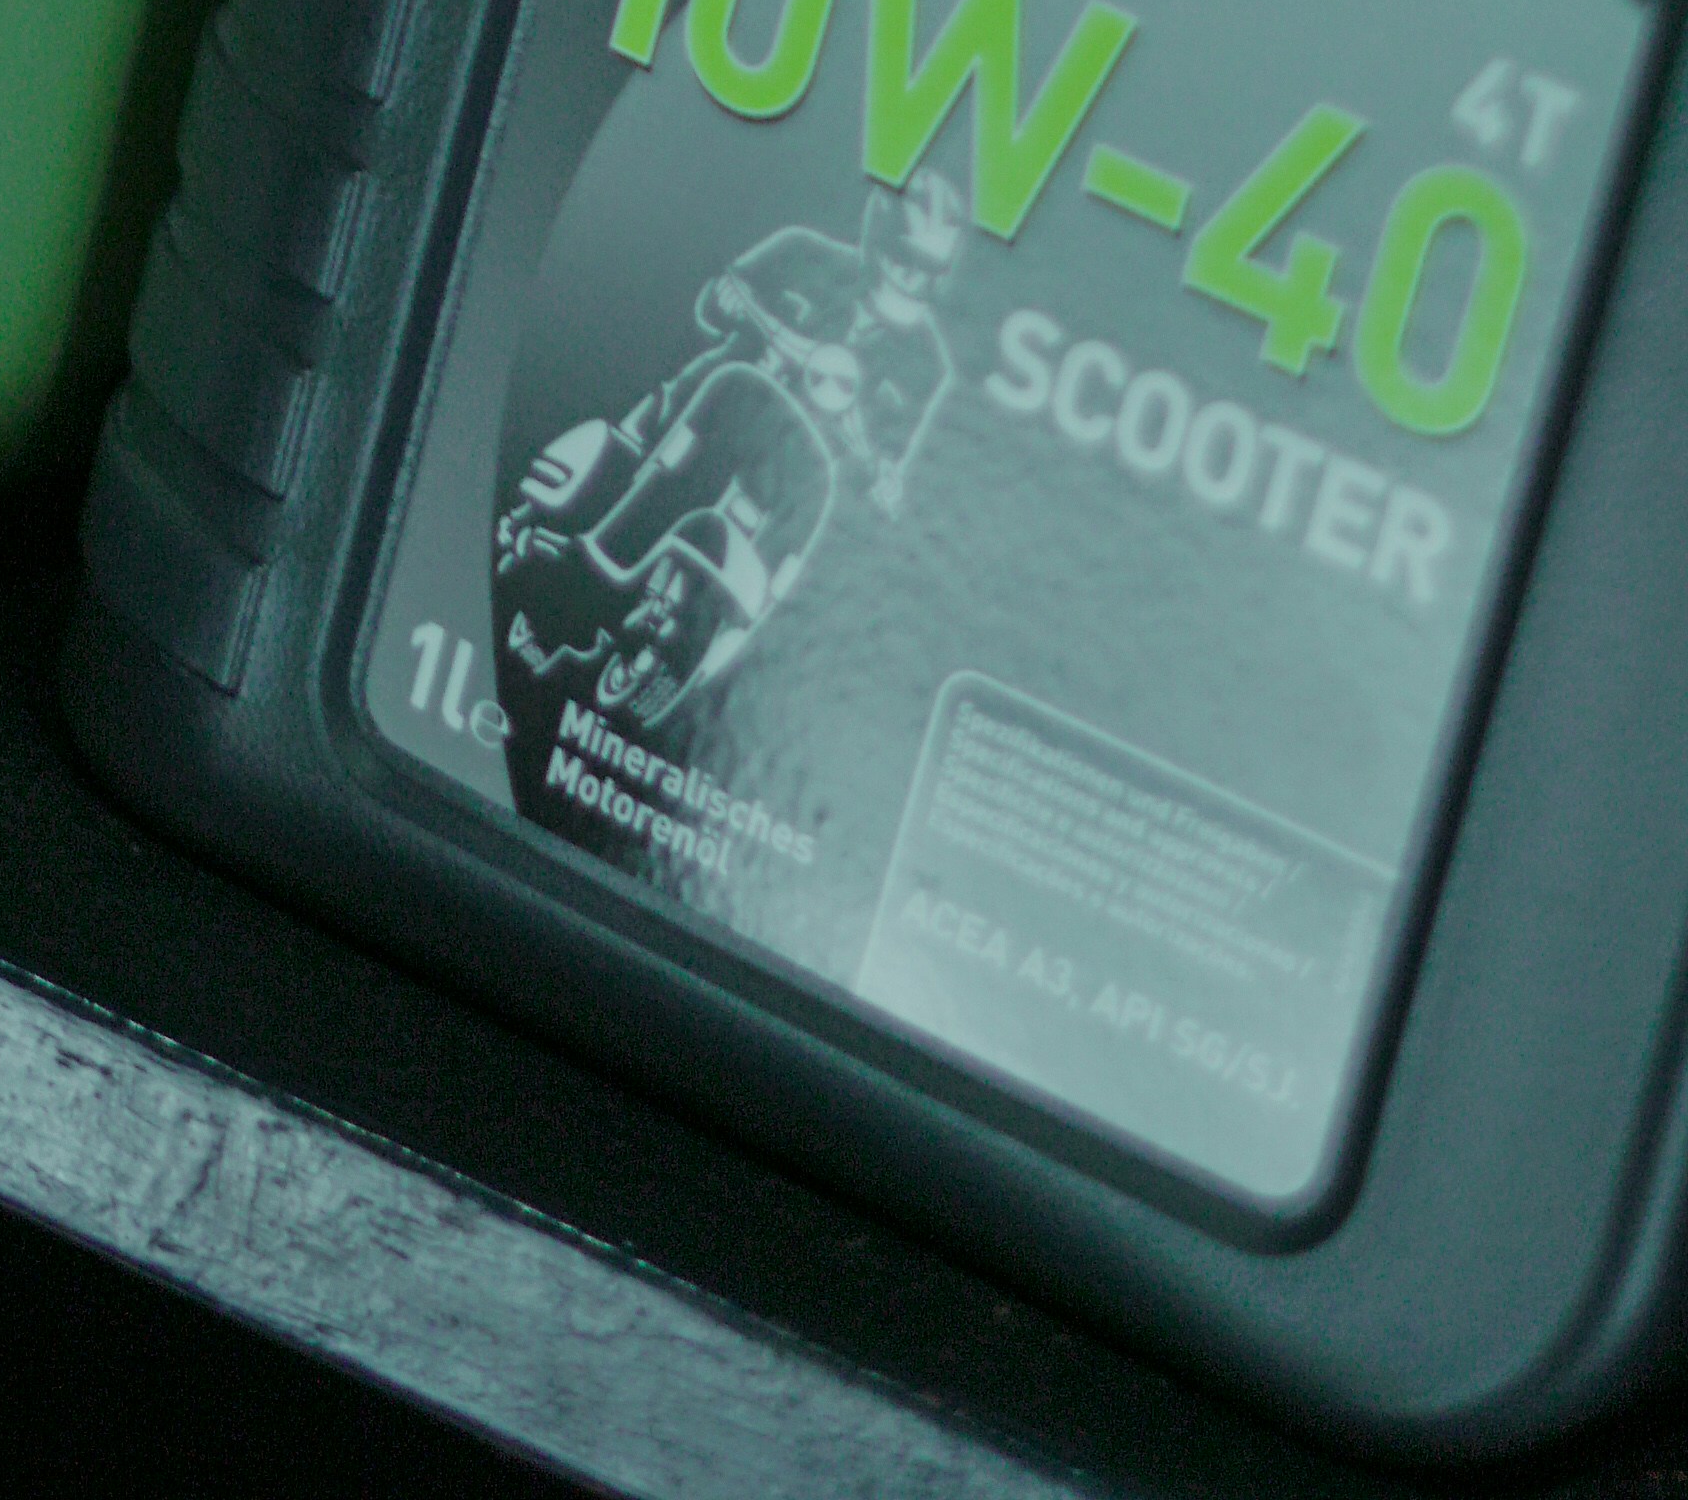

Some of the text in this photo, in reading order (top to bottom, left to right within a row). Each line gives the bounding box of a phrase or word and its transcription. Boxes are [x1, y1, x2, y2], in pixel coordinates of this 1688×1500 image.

[1452, 58, 1580, 167] 4T
[986, 307, 1451, 602] SCOOTER
[546, 745, 732, 875] Motorenöl
[559, 700, 816, 865] Mineralisches
[902, 888, 1015, 965] ACEA
[1092, 983, 1166, 1038] API
